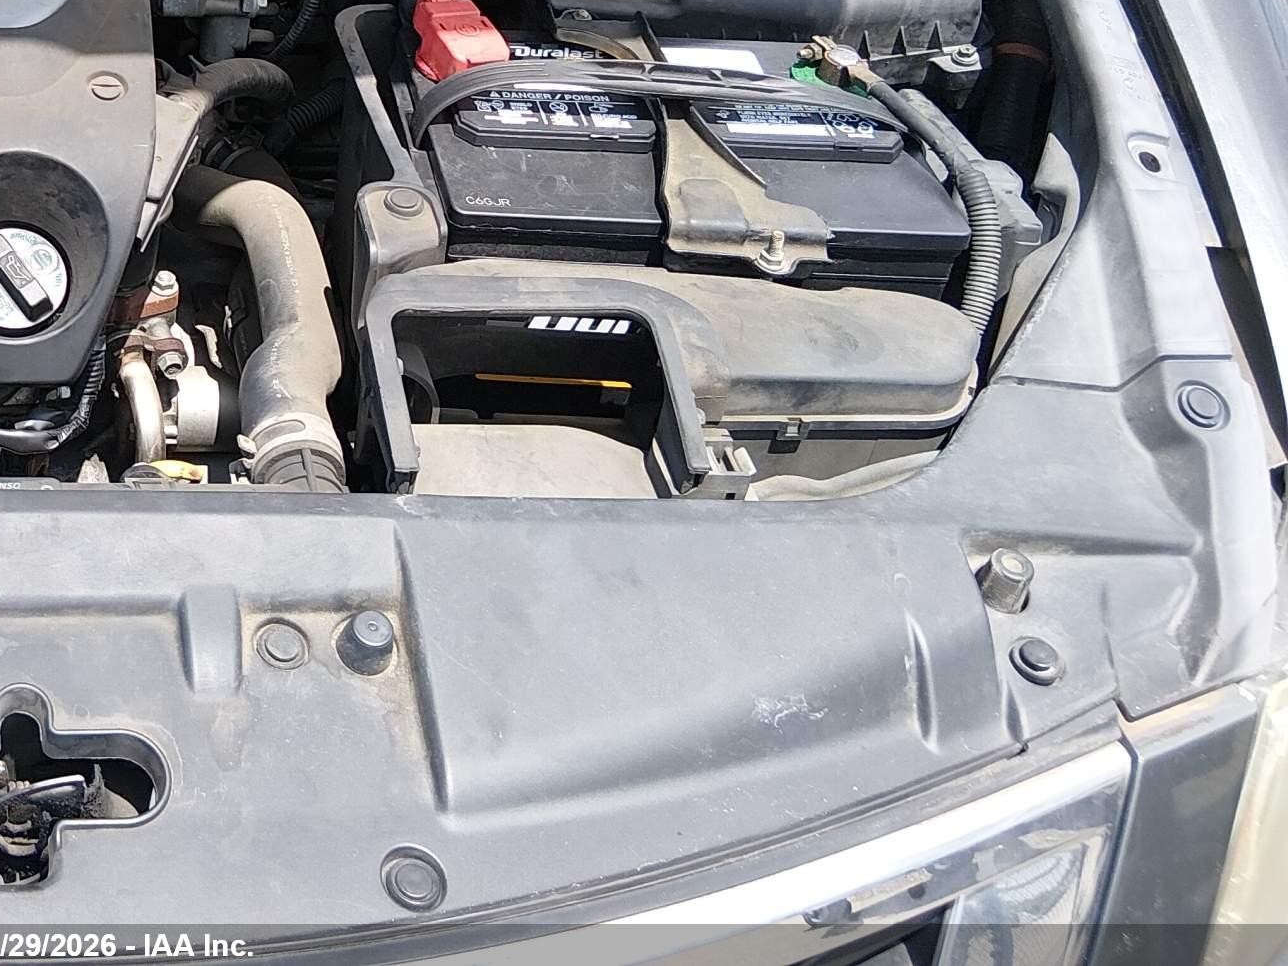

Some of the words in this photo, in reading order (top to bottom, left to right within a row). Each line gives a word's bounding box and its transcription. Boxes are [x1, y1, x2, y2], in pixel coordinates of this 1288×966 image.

[510, 45, 605, 60] Duralast
[502, 90, 552, 100] DANGER
[564, 94, 610, 103] POISON
[465, 196, 512, 207] C6GJR
